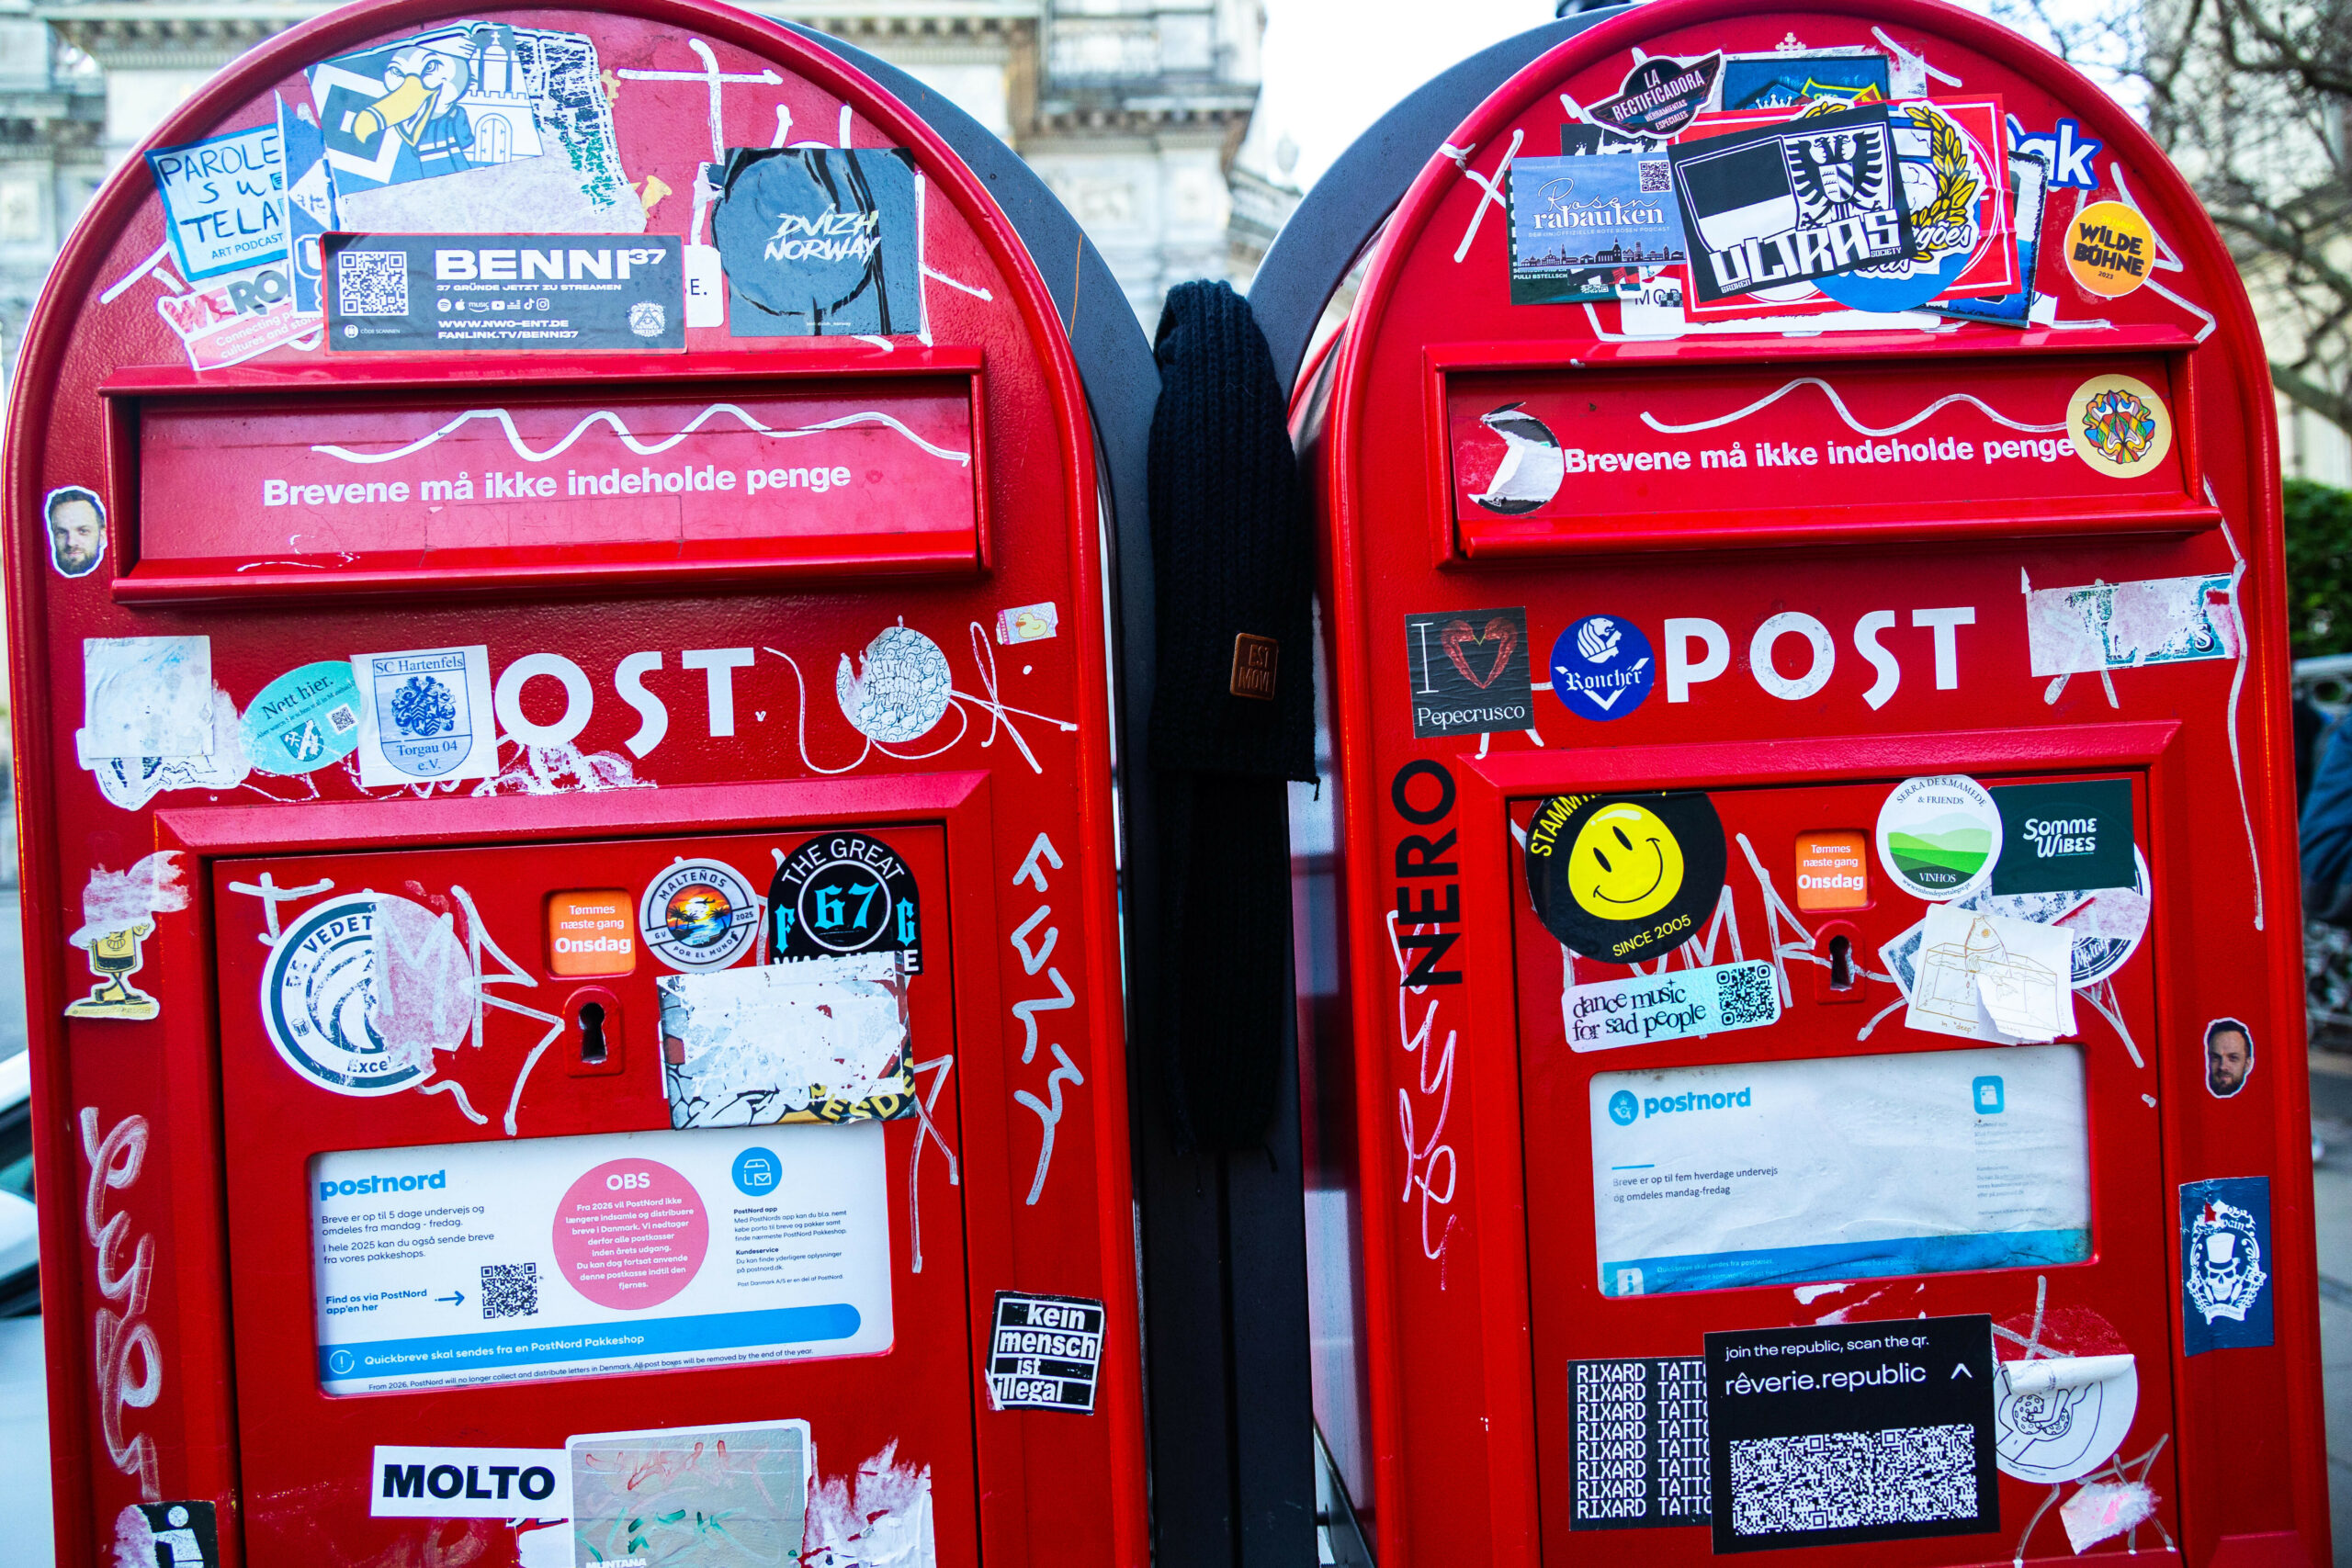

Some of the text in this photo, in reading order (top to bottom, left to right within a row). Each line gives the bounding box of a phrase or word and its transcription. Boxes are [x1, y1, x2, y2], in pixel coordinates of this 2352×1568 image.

[1644, 68, 1661, 87] LA
[1612, 70, 1705, 122] RECTIFICADORA
[1655, 109, 1689, 131] ESPECIALES
[158, 135, 281, 186] PAROLE
[1538, 177, 1658, 211] Rosen
[180, 201, 279, 243] TELA
[1532, 202, 1665, 230] rabauken
[211, 232, 284, 259] ART PODCAST
[1709, 209, 1900, 286] ULTRAS
[2079, 222, 2143, 255] WILDE
[763, 237, 881, 265] NORWAY
[1870, 246, 1902, 257] SOCIETY
[1721, 277, 1751, 294] BROKEN
[2098, 271, 2113, 279] 2023
[453, 282, 500, 291] GRÜNDE
[438, 331, 578, 339] FANLINK.TV/BENNI37
[1565, 435, 2075, 474] Brevene må ikke indeholde penge
[263, 465, 852, 507] Brevene må ikke indeholde penge
[375, 655, 464, 673] SC Hartenfels
[1664, 606, 1976, 711] POST
[261, 694, 299, 720] Nett
[297, 676, 334, 699] hier.
[1417, 705, 1525, 729] Pepecrusco
[396, 741, 458, 761] Torgau 04
[418, 760, 441, 772] e.V.
[1896, 781, 1926, 804] SERRA
[1927, 778, 1939, 786] DE
[1927, 795, 1964, 805] FRIENDS
[1811, 844, 1851, 854] Tømmes
[782, 839, 905, 885] THE GREAT
[1391, 759, 1463, 987] NERO
[1803, 857, 1859, 869] næste gang
[658, 870, 727, 901] MALTEÑOS
[1797, 874, 1864, 891] Onsdag
[1919, 873, 1957, 883] VINHOS
[569, 905, 616, 915] Tømmes
[815, 883, 880, 929] 67
[560, 919, 624, 930] næste gang
[654, 911, 754, 940] GV 2025
[1612, 914, 1691, 957] SINCE 2005
[555, 936, 631, 953] Onsdag
[673, 946, 692, 956] POR
[695, 951, 706, 959] EL
[1573, 982, 1686, 1020] dance music
[1572, 1002, 1706, 1043] for sad people
[1644, 1087, 1752, 1118] postnord
[320, 1169, 446, 1201] postnord
[606, 1172, 650, 1190] OBS
[1613, 1177, 1638, 1186] Breve
[1651, 1177, 1662, 1186] op
[1665, 1174, 1673, 1182] til
[1675, 1172, 1691, 1181] fem
[1694, 1170, 1734, 1180] hverdage
[1736, 1167, 1778, 1177] undervejs
[1613, 1186, 1730, 1203] og omdeles mandag-fredag
[322, 1215, 349, 1224] Breve
[363, 1213, 375, 1223] op
[379, 1212, 387, 1220] til
[389, 1211, 395, 1219] 5
[398, 1209, 423, 1219] dage
[424, 1206, 470, 1216] undervejs
[326, 1295, 347, 1304] Find
[363, 1293, 379, 1302] via
[380, 1289, 427, 1300] PostNord
[326, 1303, 379, 1314] app'en her
[1027, 1300, 1085, 1330] kein
[365, 1353, 428, 1365] Quickbreve
[431, 1349, 454, 1359] skal
[457, 1347, 494, 1357] sendes
[497, 1345, 513, 1354] fra
[531, 1338, 582, 1351] PostNord
[585, 1335, 645, 1347] Pakkeshop
[999, 1332, 1096, 1359] mensch
[1725, 1335, 1929, 1361] join the republic, scan the qr.
[1017, 1358, 1041, 1375] ist
[1577, 1361, 1705, 1383] RIXARD TATT
[997, 1377, 1063, 1403] illegal
[1725, 1364, 1927, 1395] rêverie.republic
[1577, 1381, 1707, 1403] RIXARD TATT
[1577, 1402, 1646, 1422] RIXARD
[1577, 1421, 1646, 1441] RIXARD
[1577, 1440, 1646, 1461] RIXARD
[1577, 1460, 1646, 1480] RIXARD
[381, 1464, 556, 1501] MOLTO
[1577, 1479, 1646, 1499] RIXARD
[1577, 1498, 1646, 1518] RIXARD
